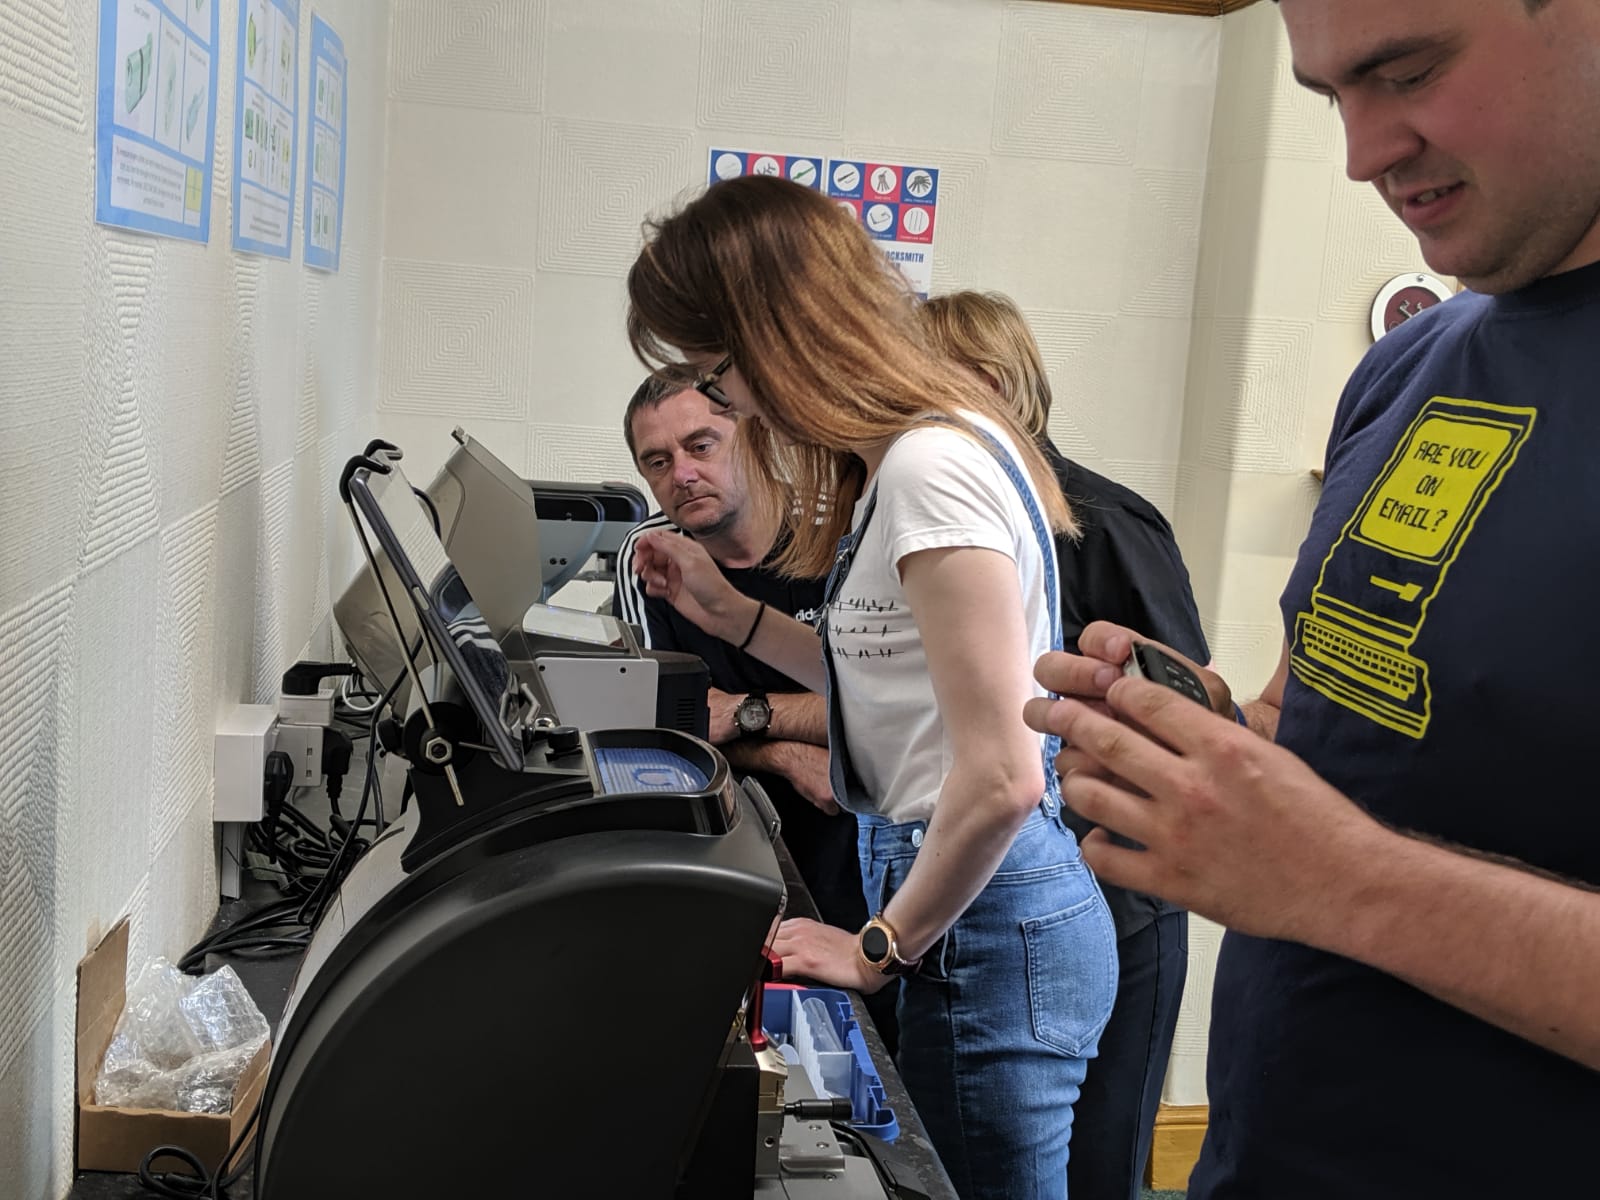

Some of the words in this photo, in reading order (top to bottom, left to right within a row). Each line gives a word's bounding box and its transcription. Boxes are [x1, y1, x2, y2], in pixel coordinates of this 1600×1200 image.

[885, 250, 924, 263] OCKSMITH
[1413, 440, 1451, 465] ARE
[1448, 447, 1490, 470] YOU
[1416, 474, 1444, 497] ON
